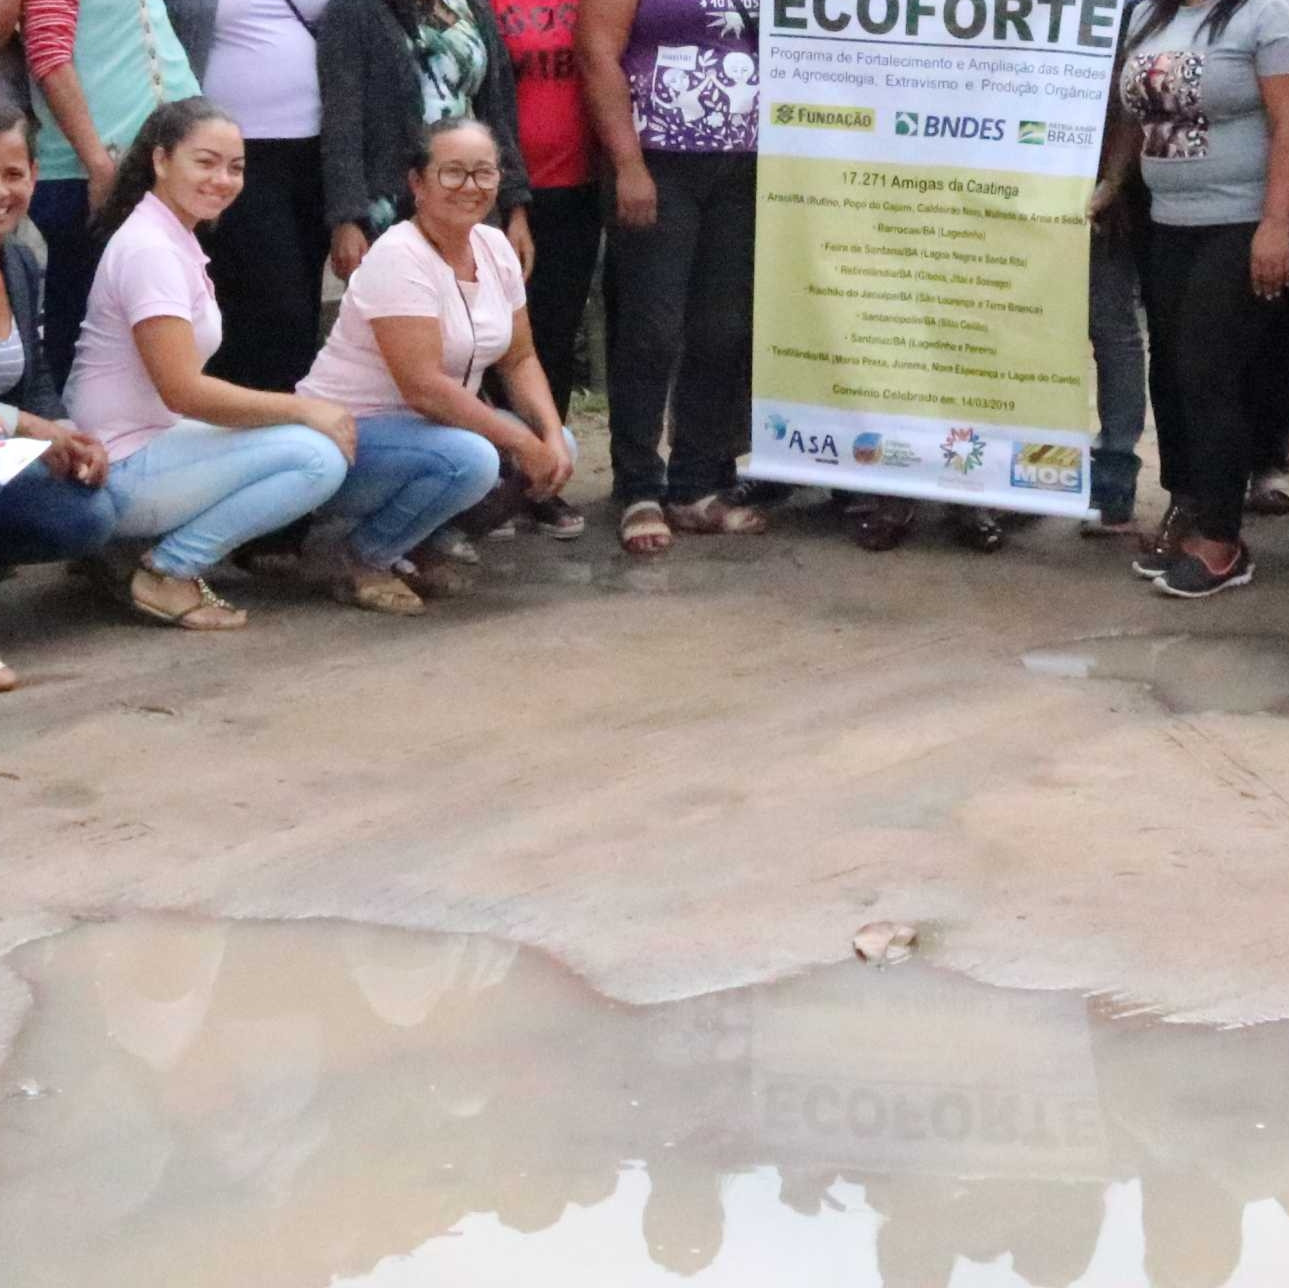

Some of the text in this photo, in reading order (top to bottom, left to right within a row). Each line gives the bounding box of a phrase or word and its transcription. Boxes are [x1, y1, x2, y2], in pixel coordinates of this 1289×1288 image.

[770, 46, 1106, 80] Programa de Fortalecimento e Ampliação das Redes
[770, 67, 786, 79] de
[965, 82, 974, 90] e
[981, 78, 1039, 97] Produção
[1044, 82, 1102, 100] Orgânica
[798, 107, 873, 128] FUNDAÇÃO
[923, 115, 1006, 141] BNDES
[1048, 129, 1094, 144] BRASIL
[842, 171, 1019, 199] 17.271 Amigas da Caatinga
[962, 396, 1016, 411] 14/03/2019
[1015, 463, 1078, 486] MOC
